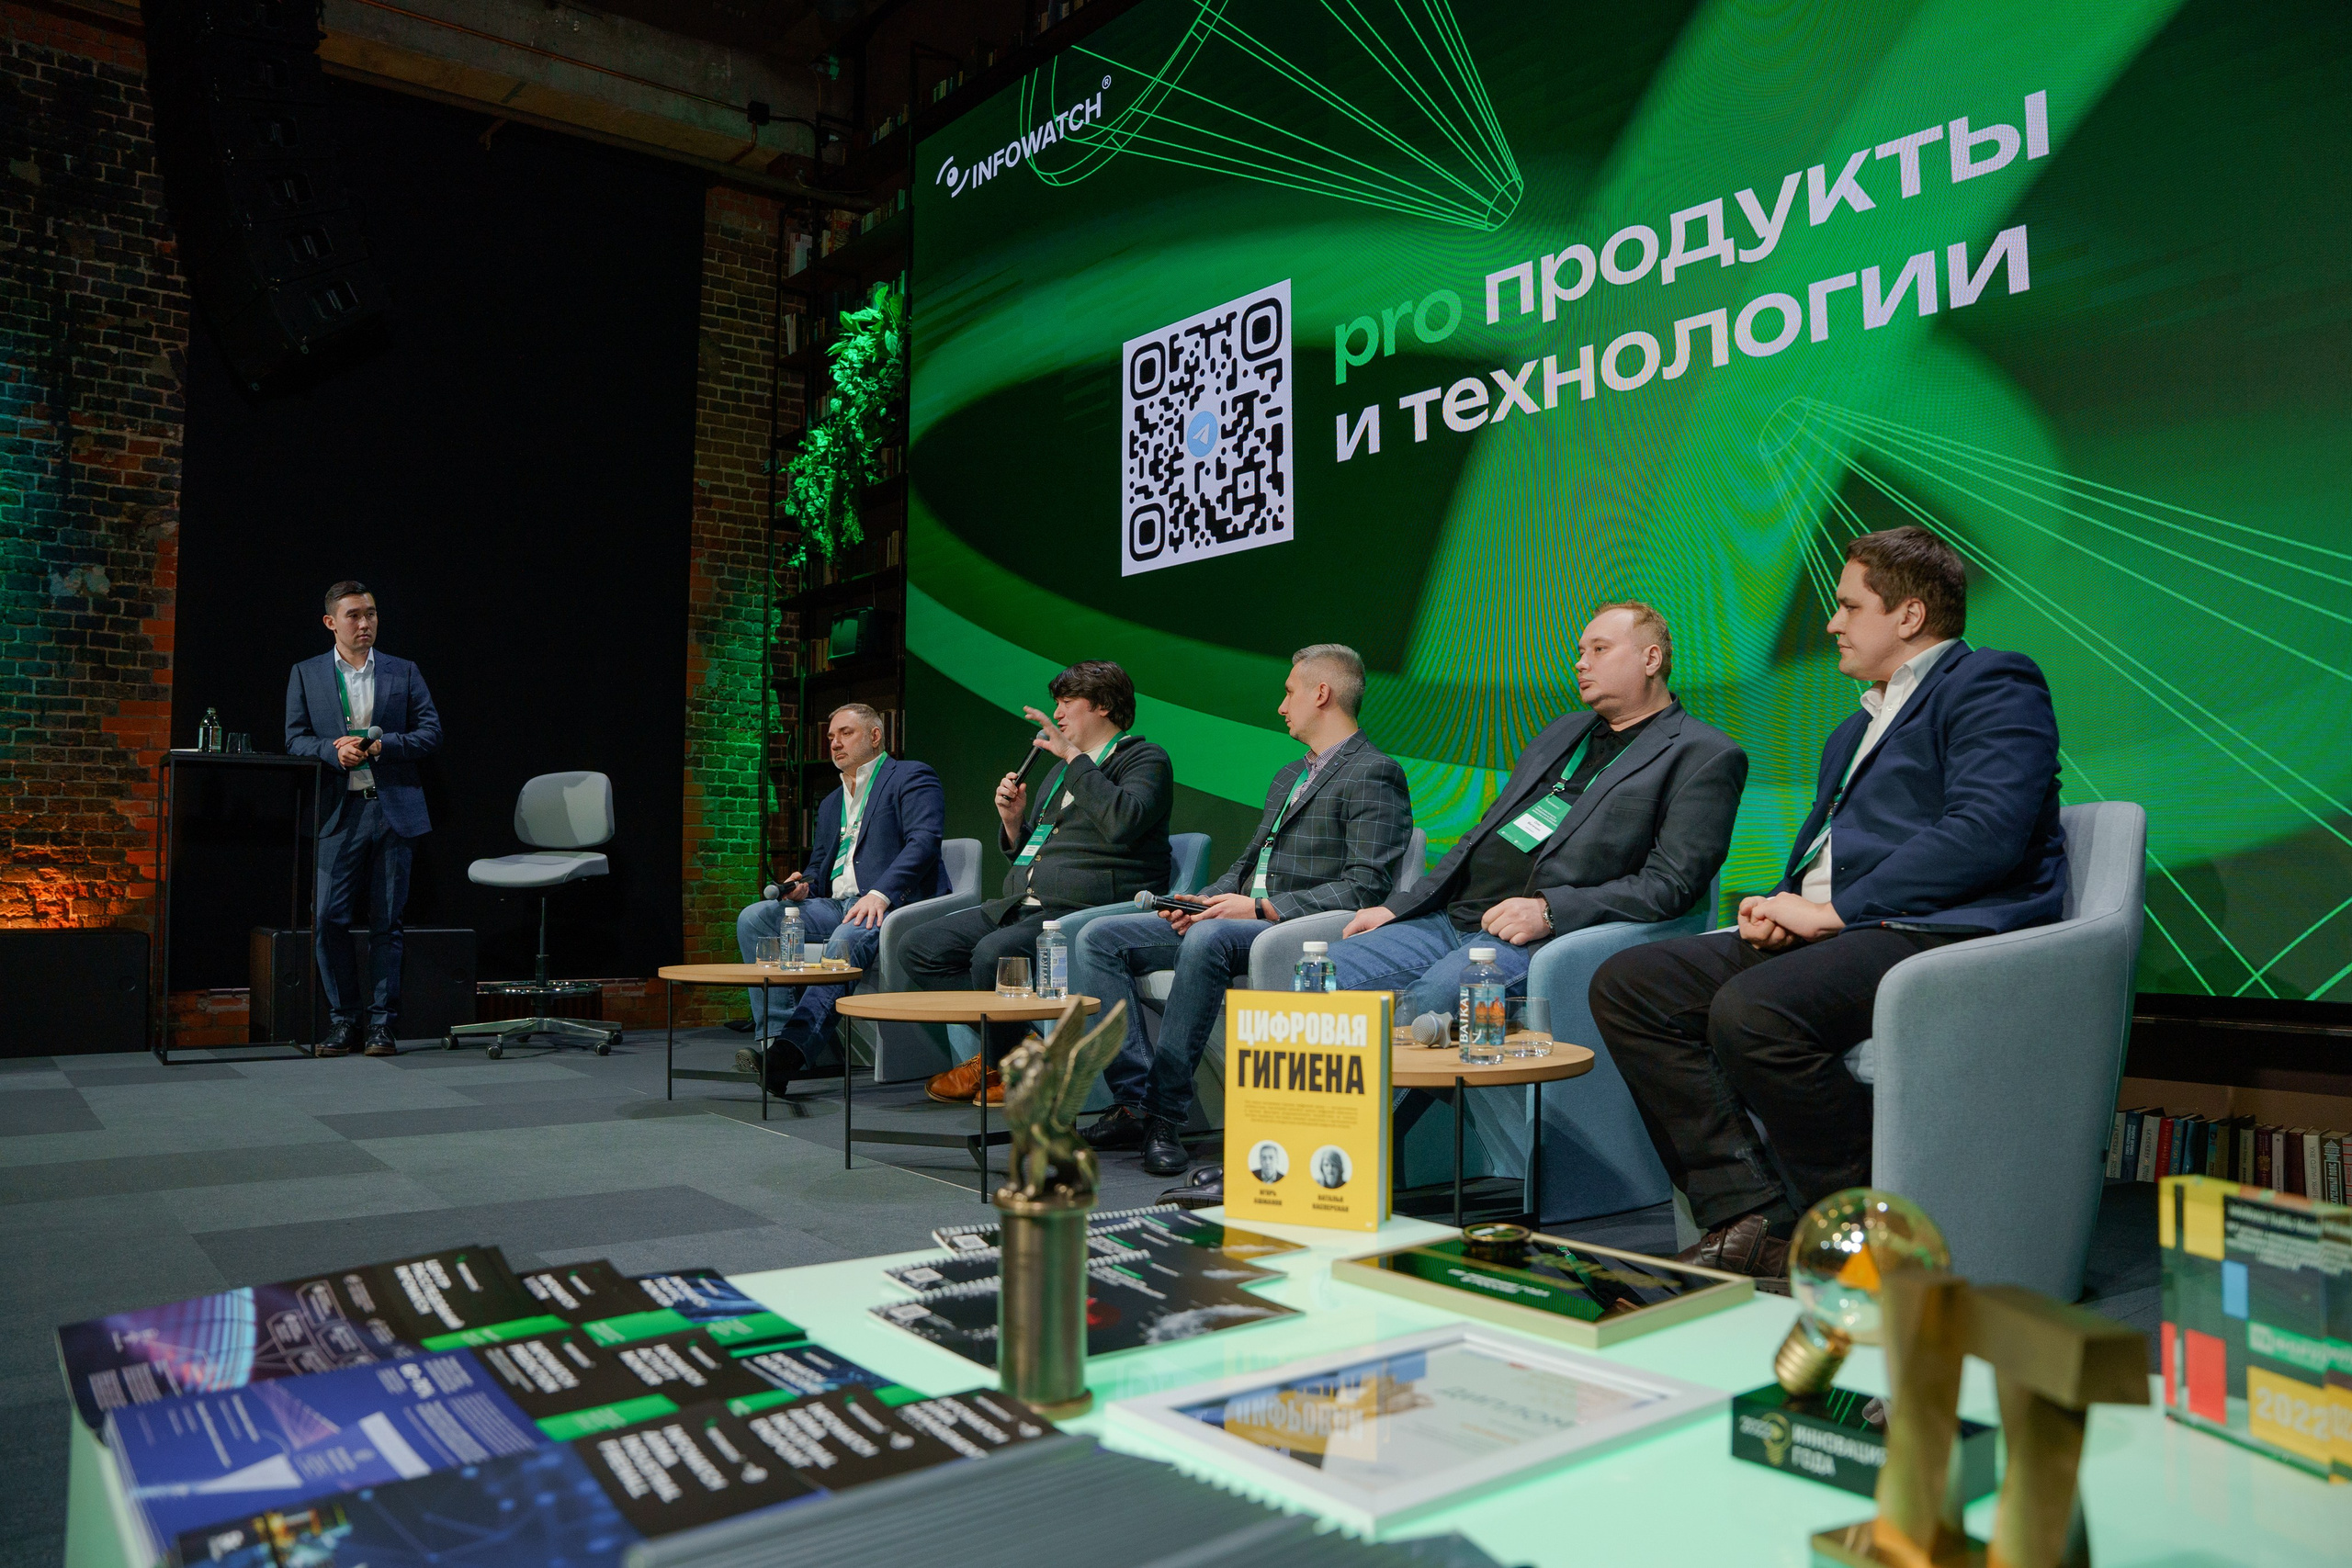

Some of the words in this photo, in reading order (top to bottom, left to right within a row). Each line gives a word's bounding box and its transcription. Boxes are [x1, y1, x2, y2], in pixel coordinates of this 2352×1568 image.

[1335, 285, 1463, 385] pro
[1485, 89, 2051, 326] продукты
[1336, 404, 1380, 463] и
[1399, 224, 2030, 443] технологии
[1237, 1009, 1368, 1048] ЦИФРОВАЯ
[1459, 988, 1470, 1043] BAIKAL
[1238, 1049, 1365, 1095] ГИГИЕНА
